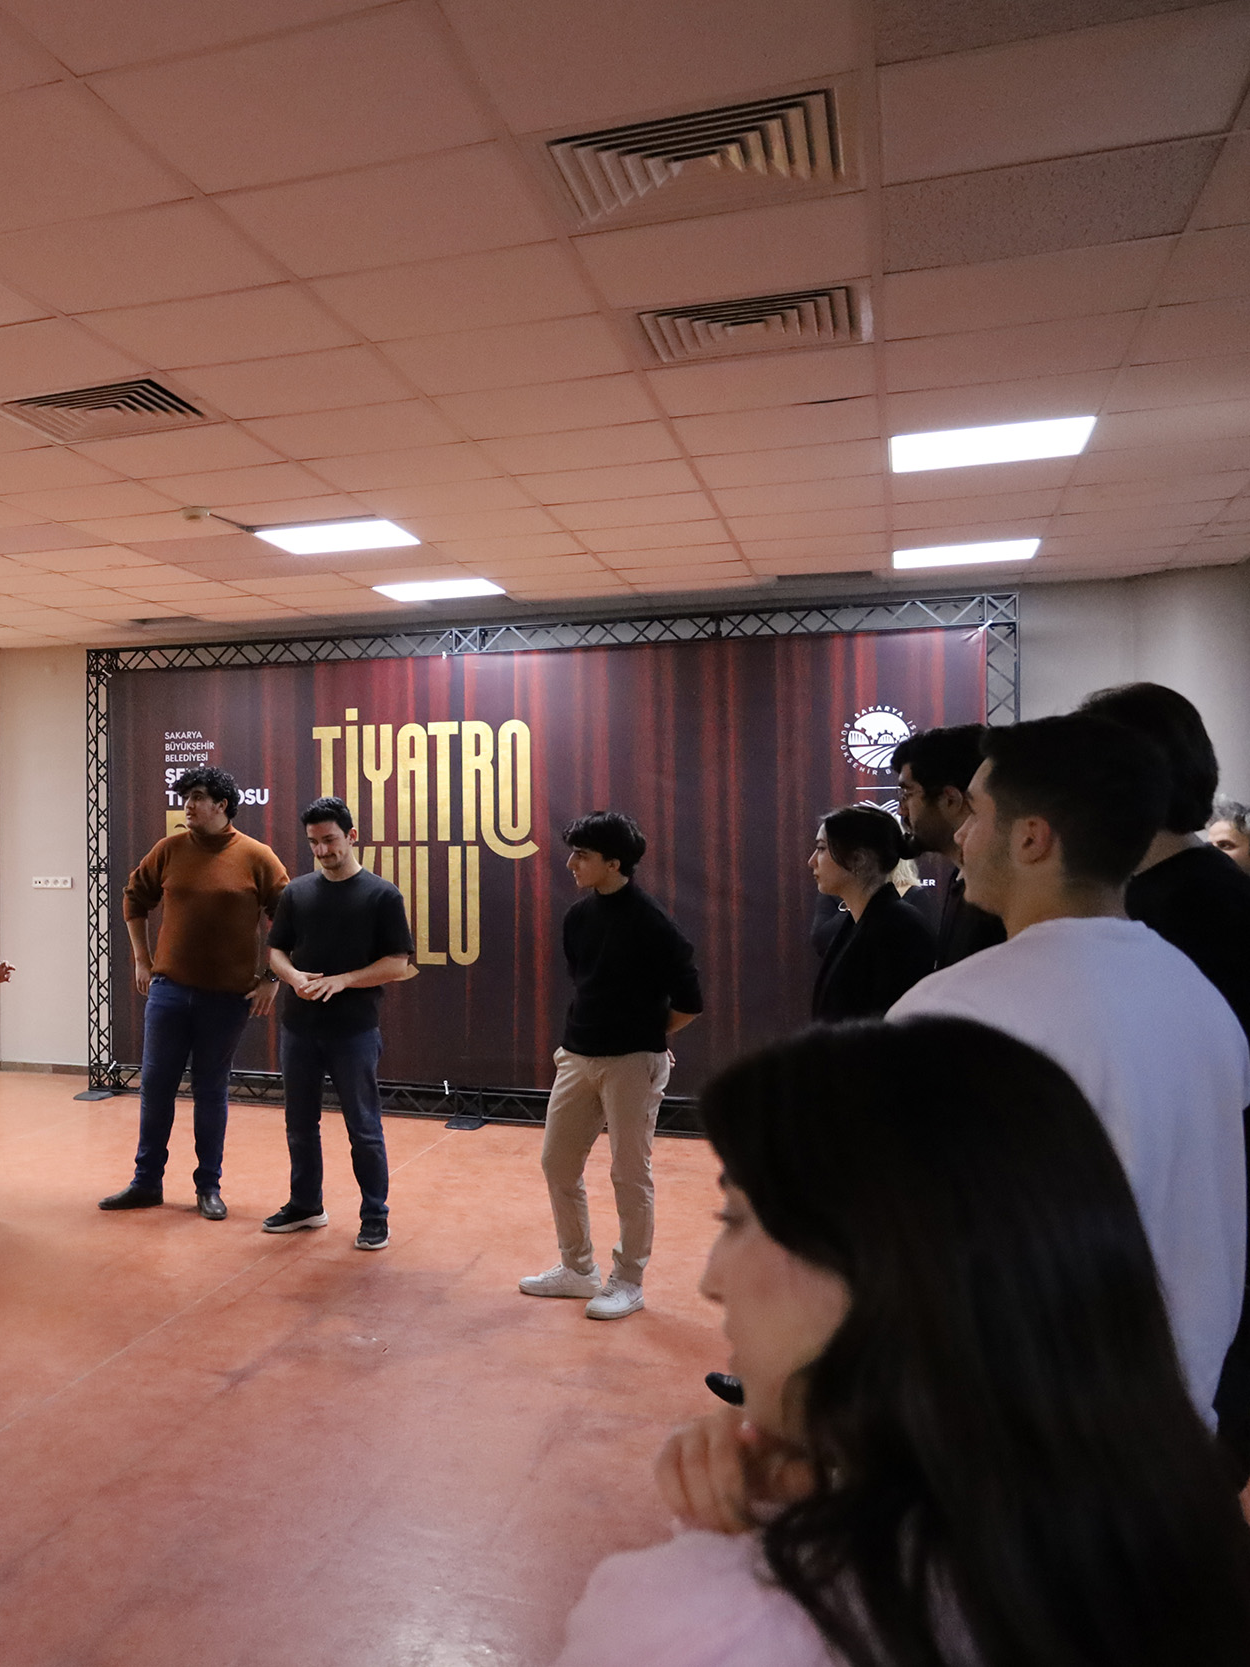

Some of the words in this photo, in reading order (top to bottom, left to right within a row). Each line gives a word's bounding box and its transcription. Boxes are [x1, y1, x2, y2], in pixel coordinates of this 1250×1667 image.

[854, 705, 903, 719] SAKARYA
[164, 731, 202, 740] SAKARYA
[164, 740, 215, 752] BÜYÜKŞEHİR
[165, 752, 208, 762] BELEDİYESİ
[312, 708, 540, 859] TİYATRO
